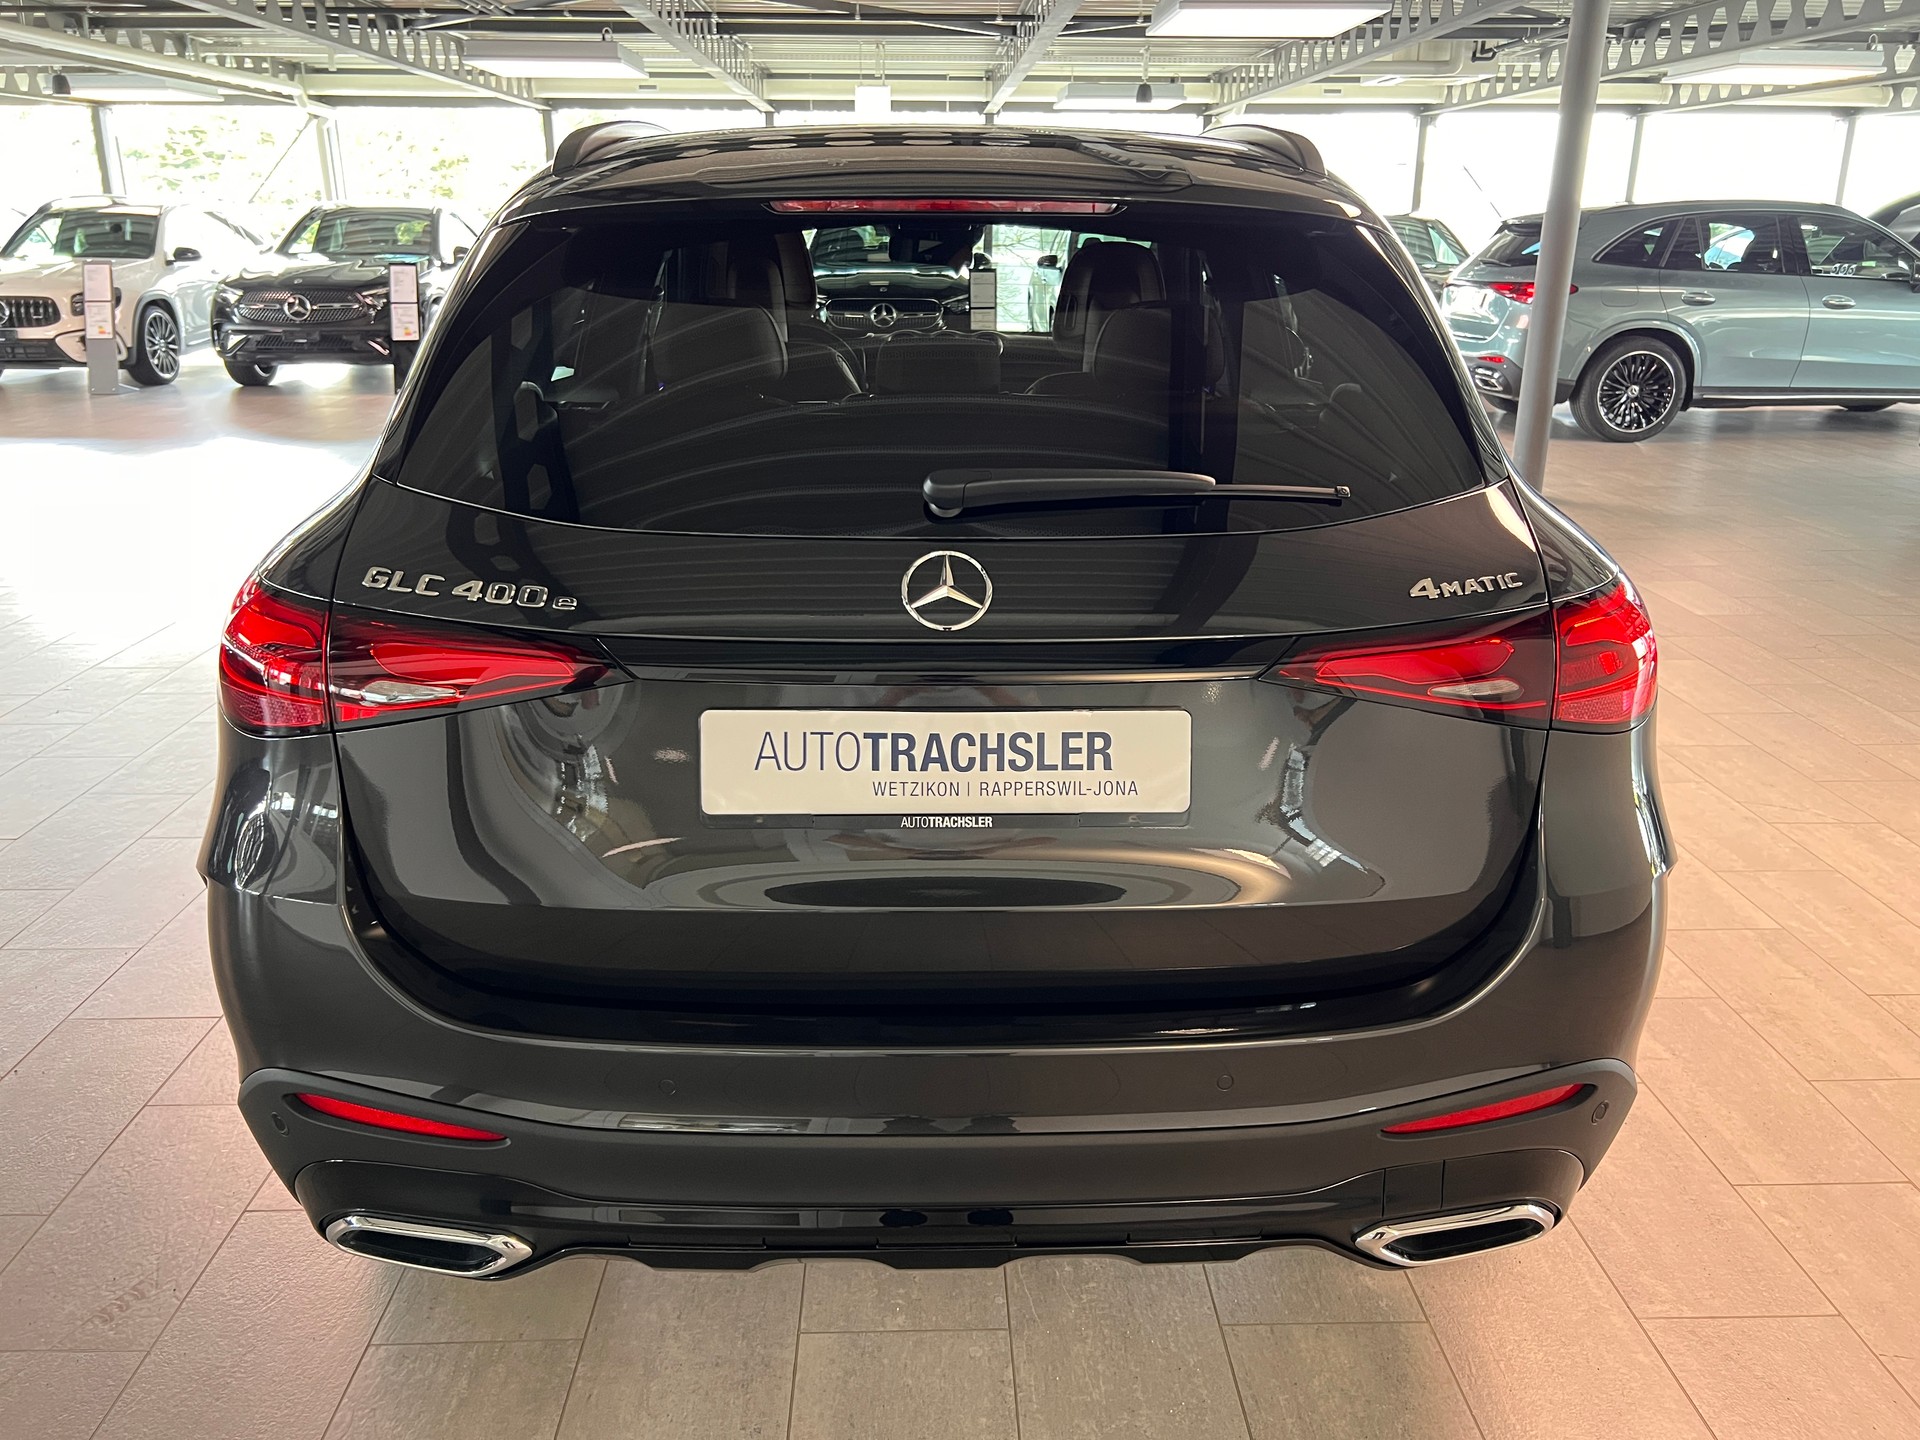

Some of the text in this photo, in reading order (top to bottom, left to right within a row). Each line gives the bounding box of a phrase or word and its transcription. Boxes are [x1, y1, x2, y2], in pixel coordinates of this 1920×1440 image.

[361, 566, 446, 596] GLC
[1409, 572, 1523, 599] 4MATIC
[754, 731, 1114, 772] AUTOTRACHSLER
[872, 781, 961, 797] WETZIKON
[979, 780, 1139, 797] RAPPERSWIL-JONA
[900, 816, 993, 828] AUTOTRACHSLER
